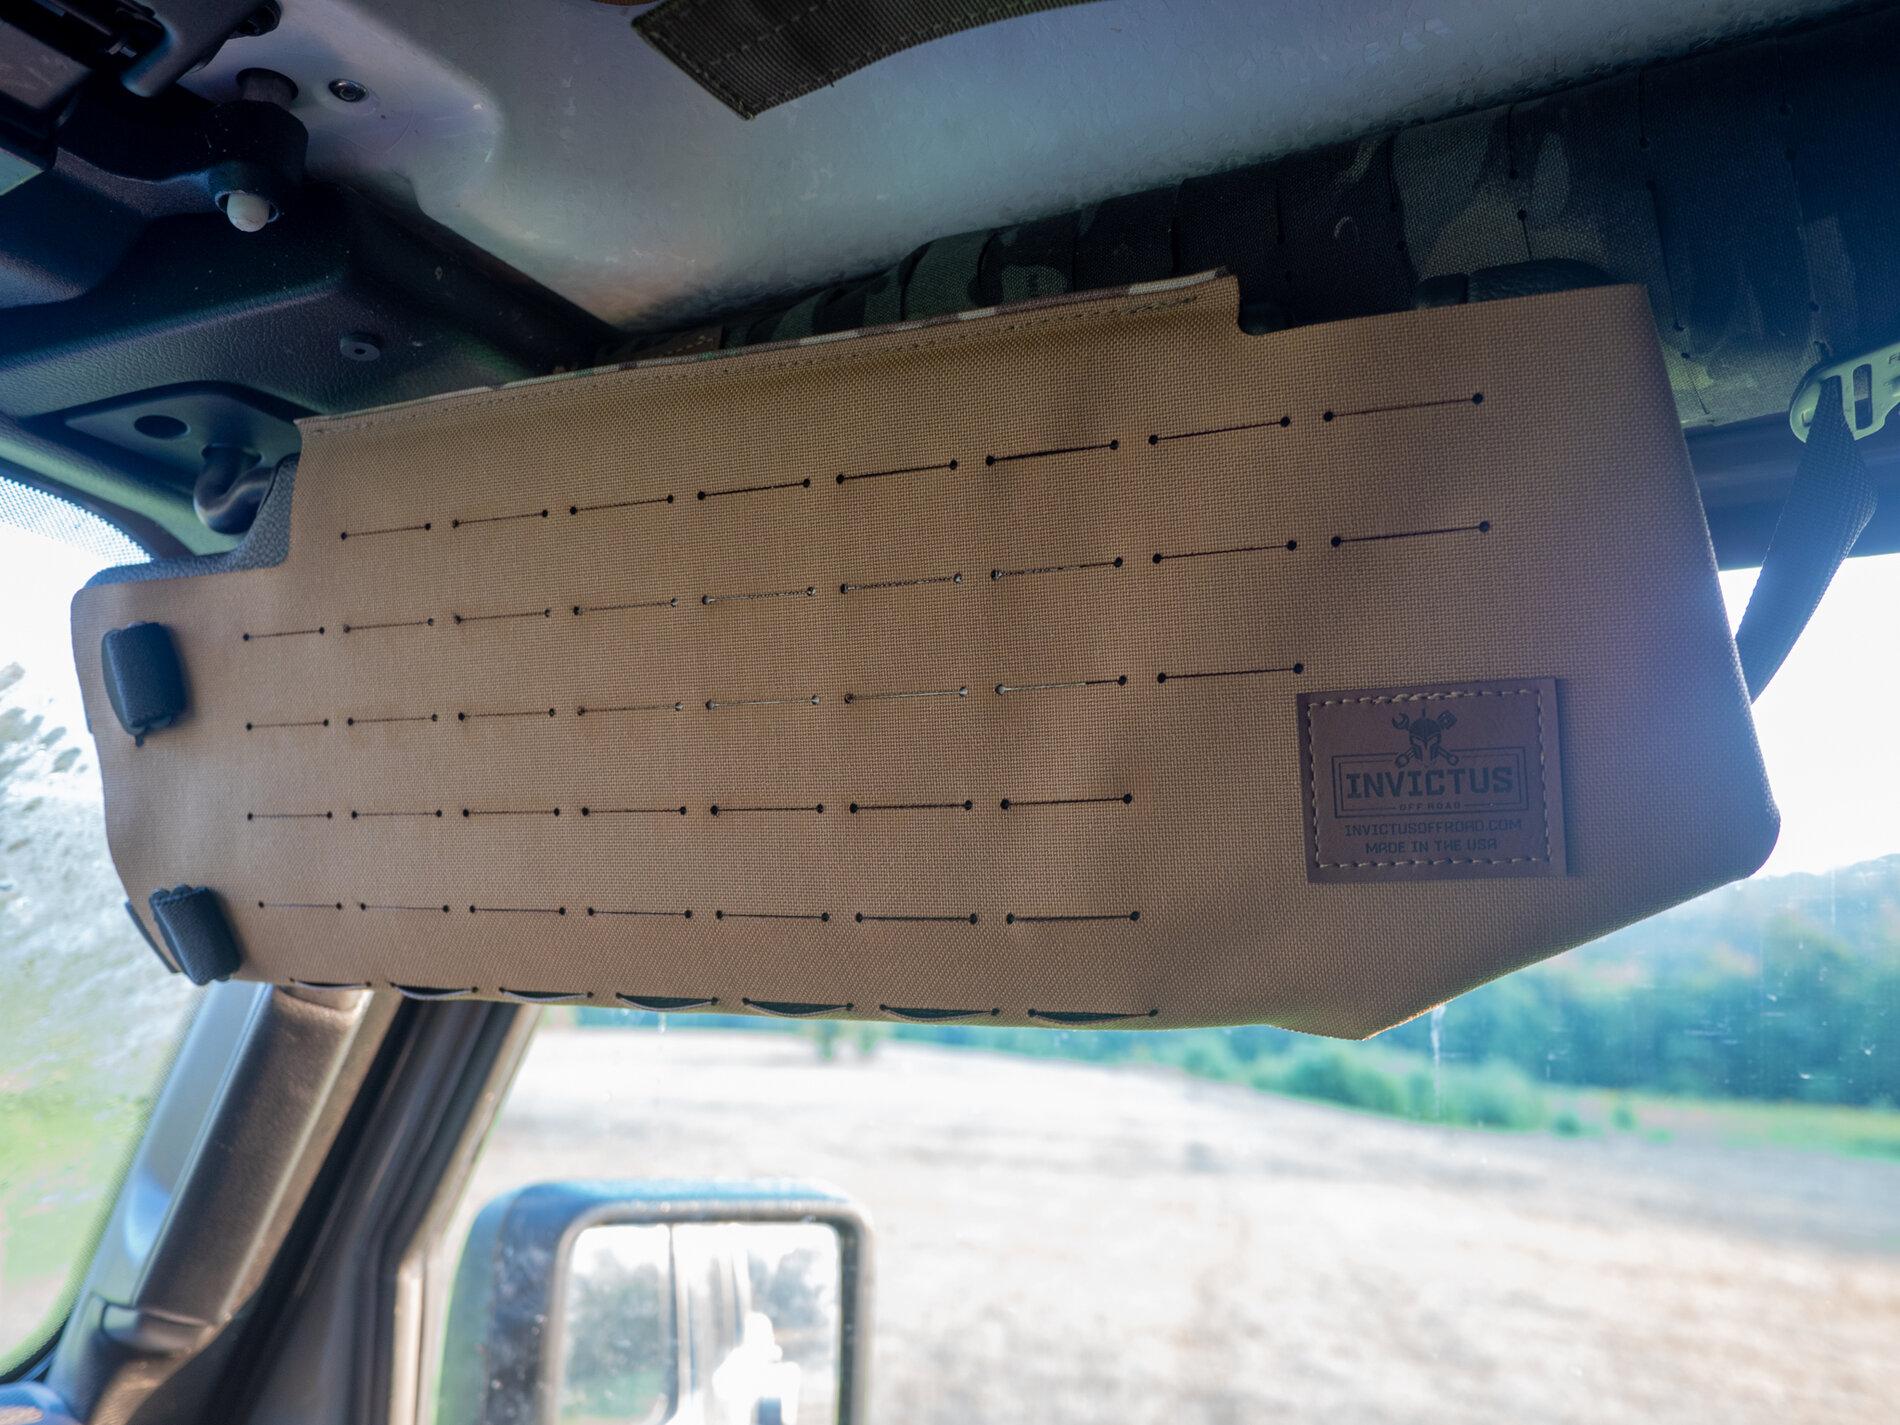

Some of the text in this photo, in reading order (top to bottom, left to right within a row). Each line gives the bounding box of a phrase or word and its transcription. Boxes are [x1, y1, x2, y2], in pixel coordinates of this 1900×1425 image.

[1345, 767, 1514, 800] INVICTUS
[1399, 801, 1461, 811] OFF ROAD
[1345, 818, 1522, 837] INVICTUSOFFROAD.COM
[1365, 838, 1498, 854] MADE IN THE USA
